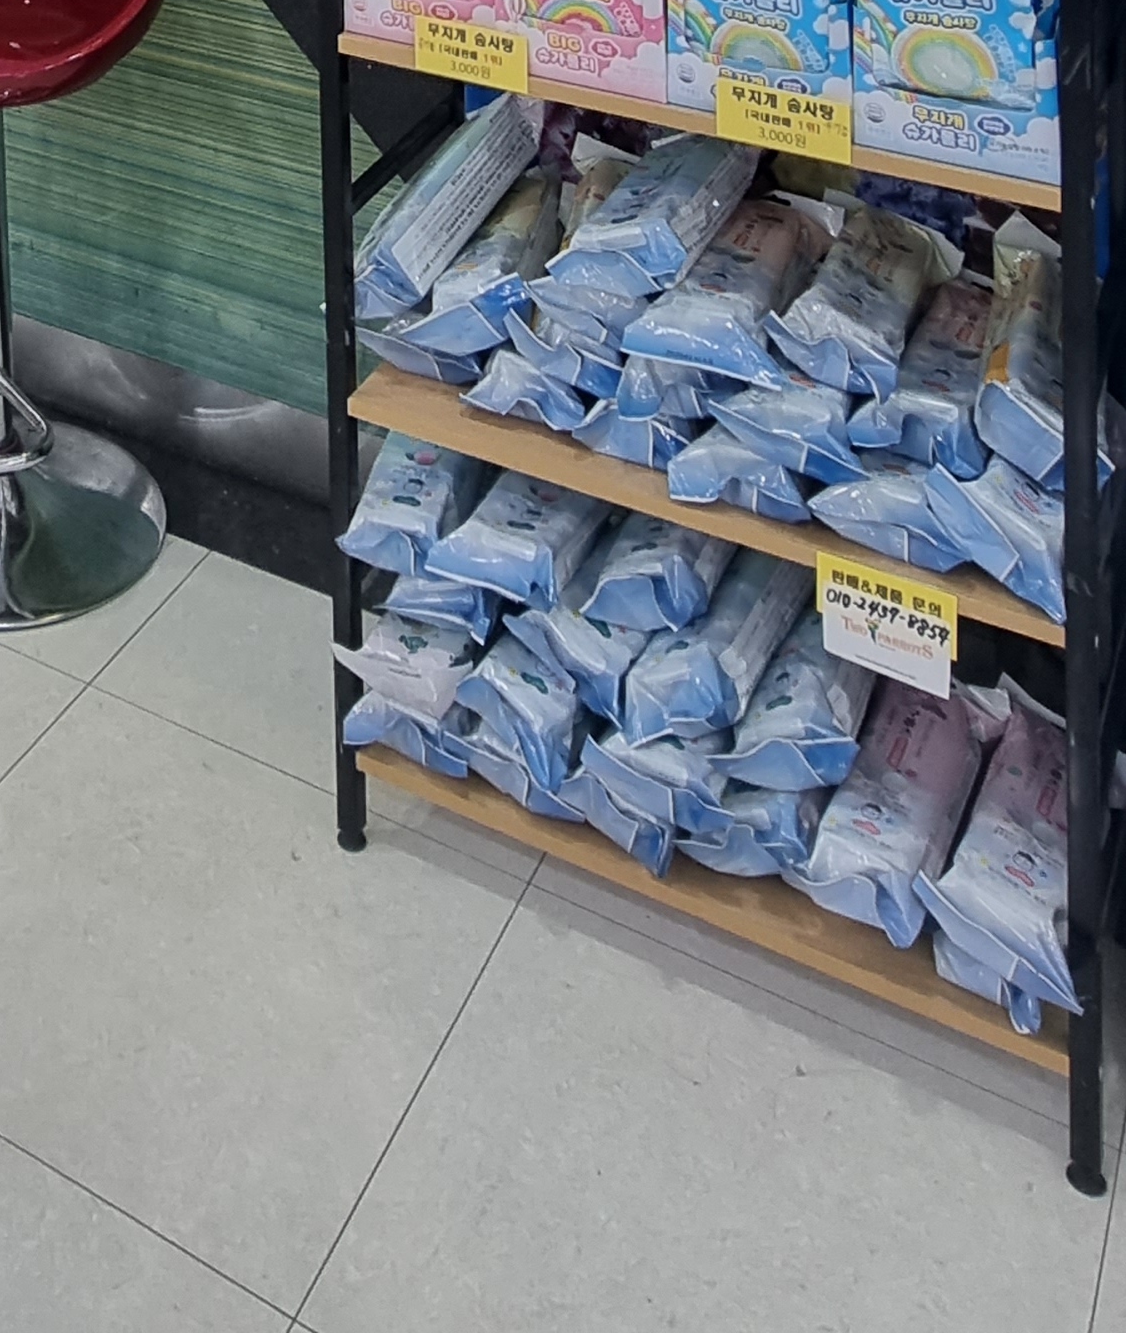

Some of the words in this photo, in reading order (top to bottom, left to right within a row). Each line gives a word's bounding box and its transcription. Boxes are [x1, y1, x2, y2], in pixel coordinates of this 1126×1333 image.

[428, 22, 466, 44] 무지개
[474, 32, 514, 53] 솜사탕
[546, 31, 582, 52] BIG
[450, 60, 491, 80] 3,000원
[731, 86, 778, 110] 무지개
[787, 97, 835, 121] 솜사탕
[912, 106, 964, 130] 무지개
[758, 126, 807, 148] 3,000원
